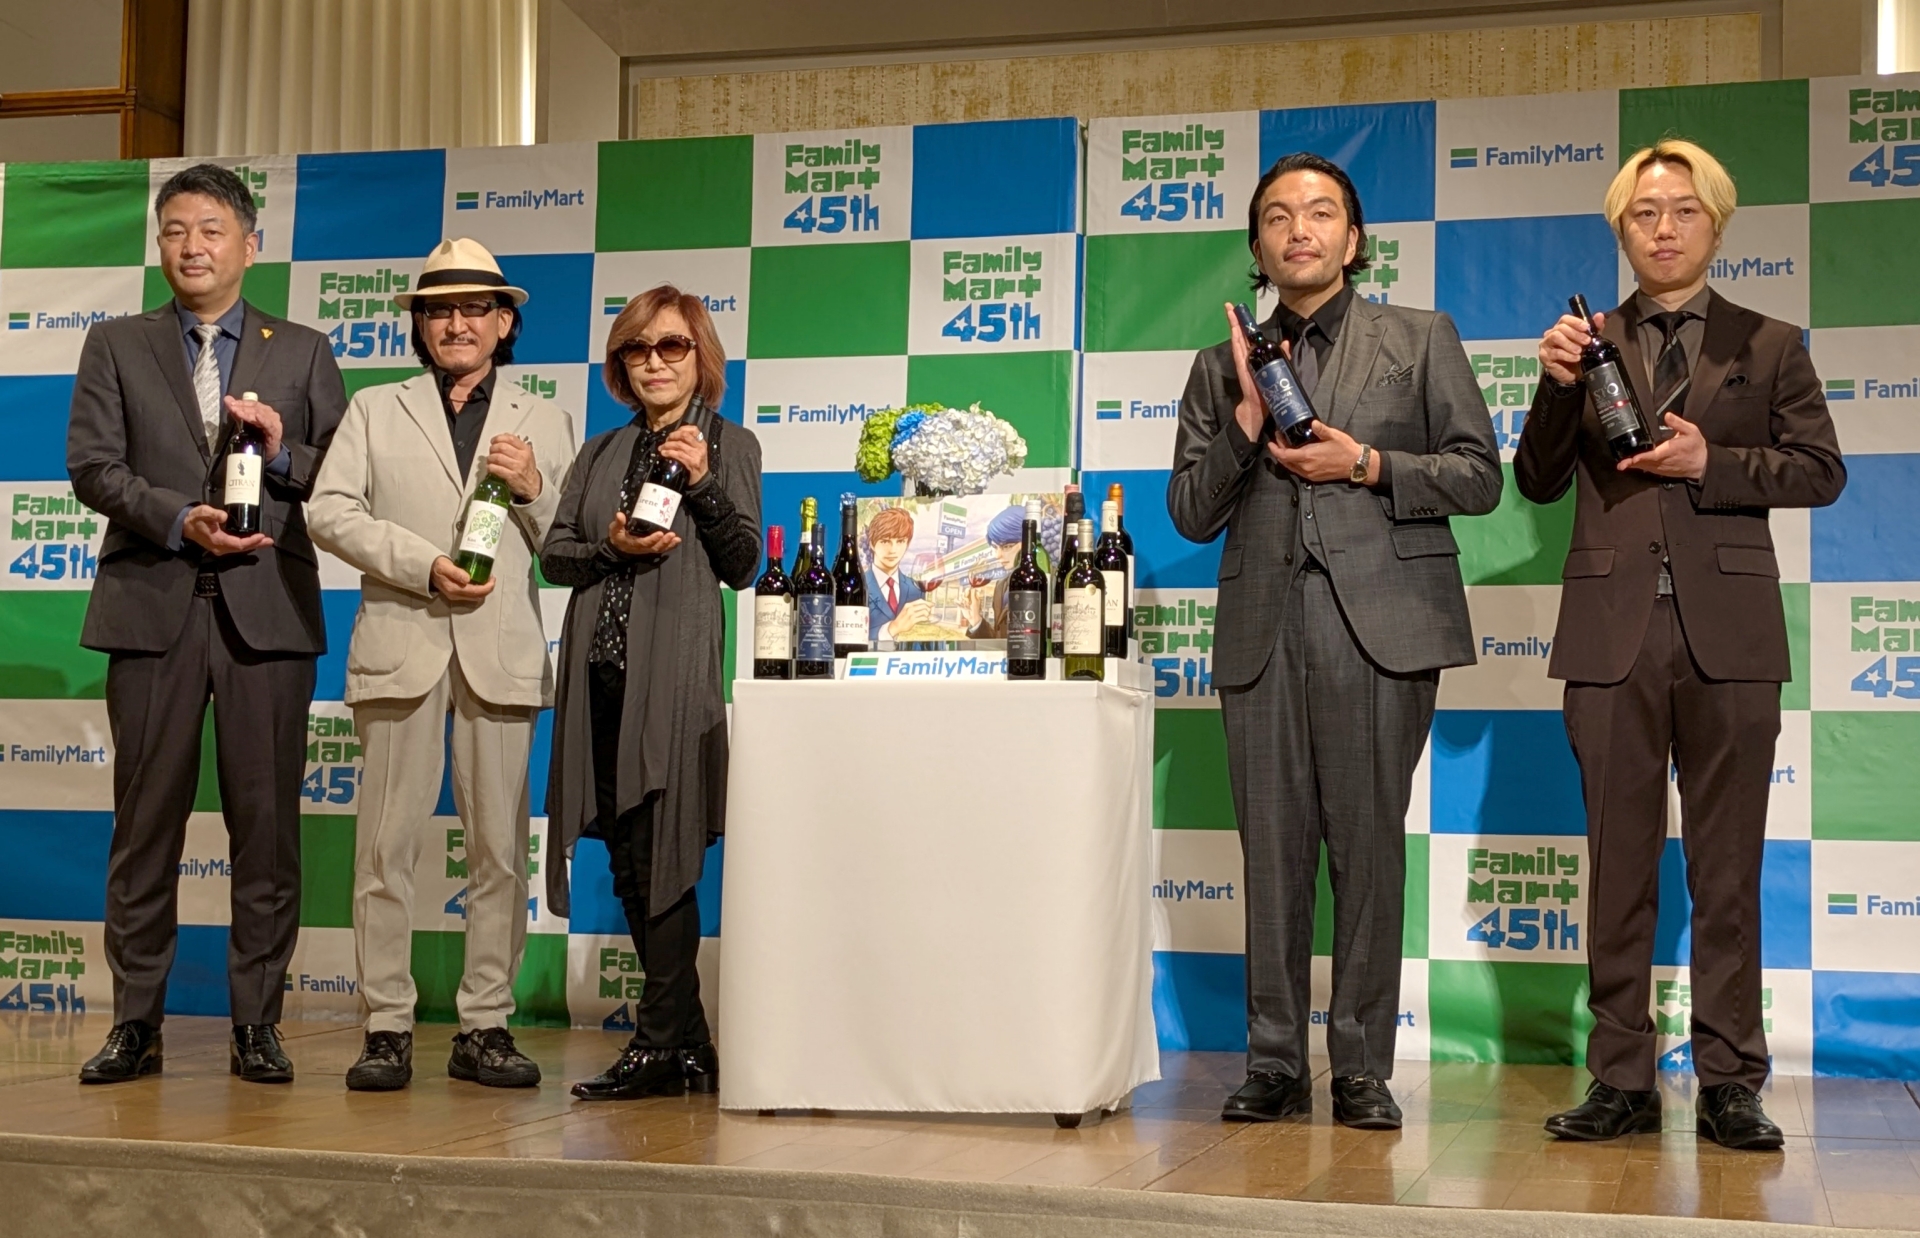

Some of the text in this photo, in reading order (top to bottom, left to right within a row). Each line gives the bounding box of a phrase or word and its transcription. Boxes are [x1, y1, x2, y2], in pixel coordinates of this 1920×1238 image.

[785, 139, 881, 167] Family
[1122, 124, 1225, 154] Family
[1122, 153, 1225, 181] Mart
[1486, 143, 1604, 166] FamilyMart
[1848, 144, 1920, 187] 45
[785, 167, 880, 194] Mart
[485, 189, 584, 209] FamilyMart
[1120, 181, 1224, 221] 45th
[783, 194, 879, 233] 45th
[943, 246, 1042, 274] Family
[320, 268, 410, 294] Family
[943, 274, 1042, 302] Mart
[941, 302, 1041, 343] 45th
[11, 517, 98, 540] Mart
[944, 526, 963, 535] OPEN
[9, 543, 97, 580] 45th
[836, 620, 864, 629] Eirene
[1134, 599, 1216, 626] amily
[886, 657, 1008, 678] FamilyMart
[1850, 655, 1920, 699] 45
[10, 745, 105, 765] FamilyMart
[1467, 847, 1579, 876] Family
[1467, 877, 1579, 905] Mart
[1466, 907, 1579, 951] 45th
